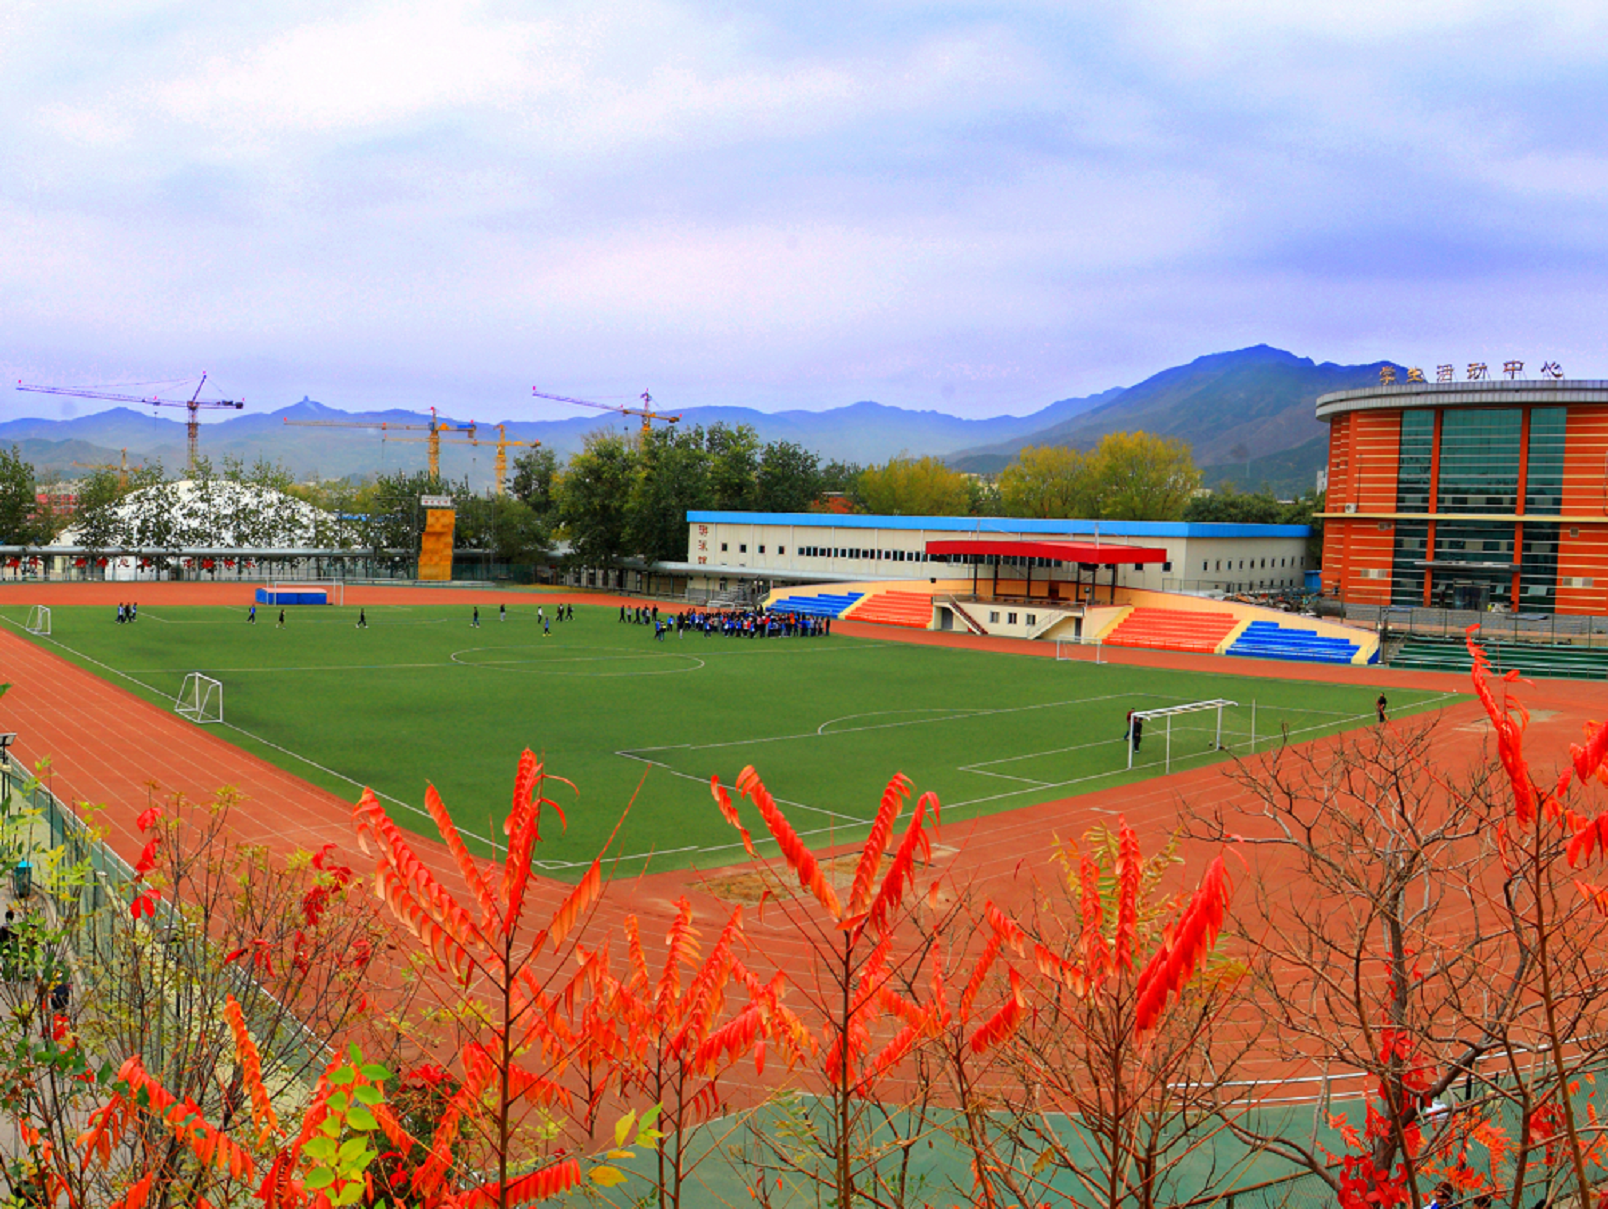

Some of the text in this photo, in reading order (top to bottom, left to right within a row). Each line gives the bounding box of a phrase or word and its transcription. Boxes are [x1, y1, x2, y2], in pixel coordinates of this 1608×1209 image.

[1379, 360, 1563, 386] 学生活动中心
